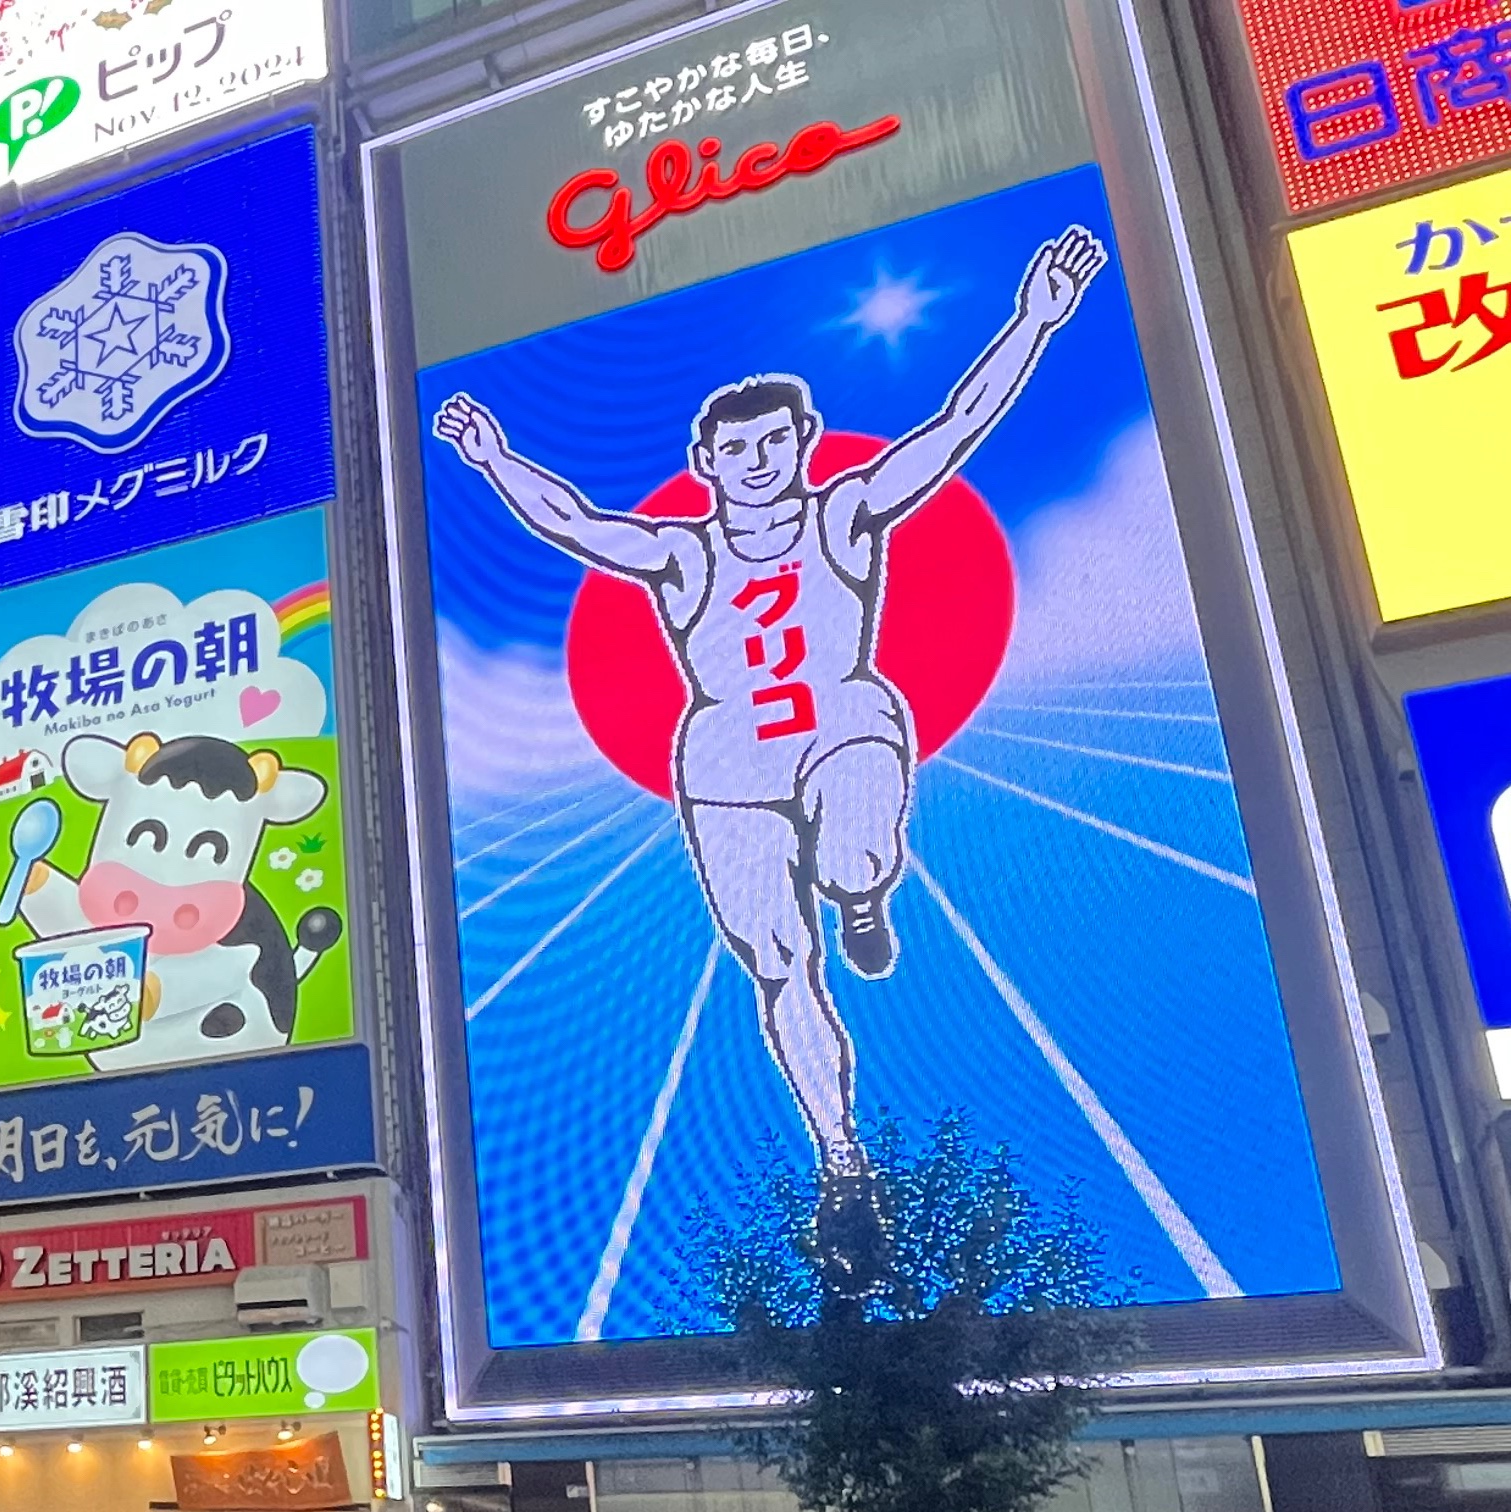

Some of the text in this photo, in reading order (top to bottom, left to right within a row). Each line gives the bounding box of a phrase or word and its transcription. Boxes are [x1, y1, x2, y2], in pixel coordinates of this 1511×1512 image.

[98, 8, 233, 102] ピップ
[583, 23, 831, 129] すこやかな毎日、
[602, 58, 810, 151] ゆたかな人生
[1395, 215, 1511, 276] か
[85, 612, 168, 644] まきばのあさ
[731, 559, 818, 742] グリコ
[0, 611, 259, 728] 牧場の朝
[43, 687, 216, 737] Makiba no Asa Yogurt
[38, 956, 127, 991] 牧場の朝
[10, 1237, 236, 1289] ZETTERIA
[212, 1355, 293, 1397] ピタットハウス
